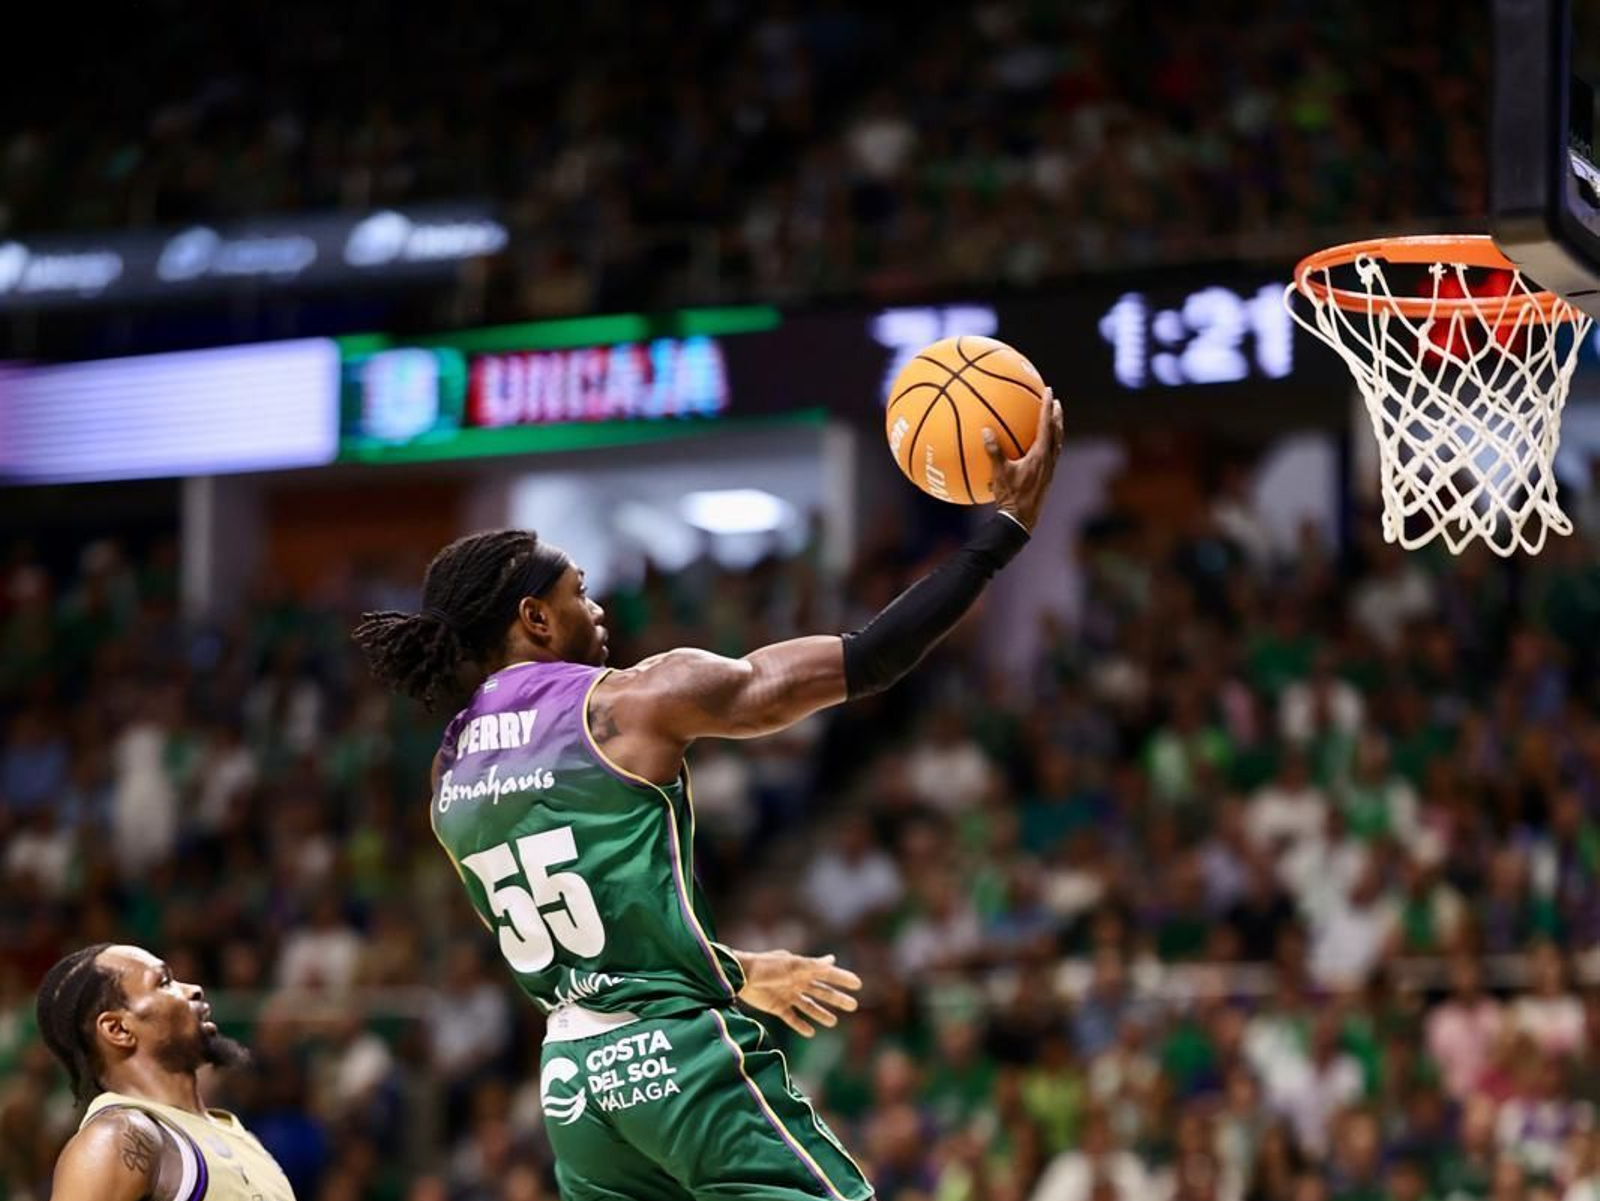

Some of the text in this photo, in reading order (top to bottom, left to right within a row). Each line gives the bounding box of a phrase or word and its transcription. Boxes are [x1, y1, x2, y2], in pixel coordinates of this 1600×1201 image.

[1100, 284, 1293, 388] 1:21
[457, 709, 538, 760] PERRY
[460, 826, 606, 974] 55
[586, 1029, 673, 1073] COSTA
[588, 1056, 677, 1095] DEL SOL
